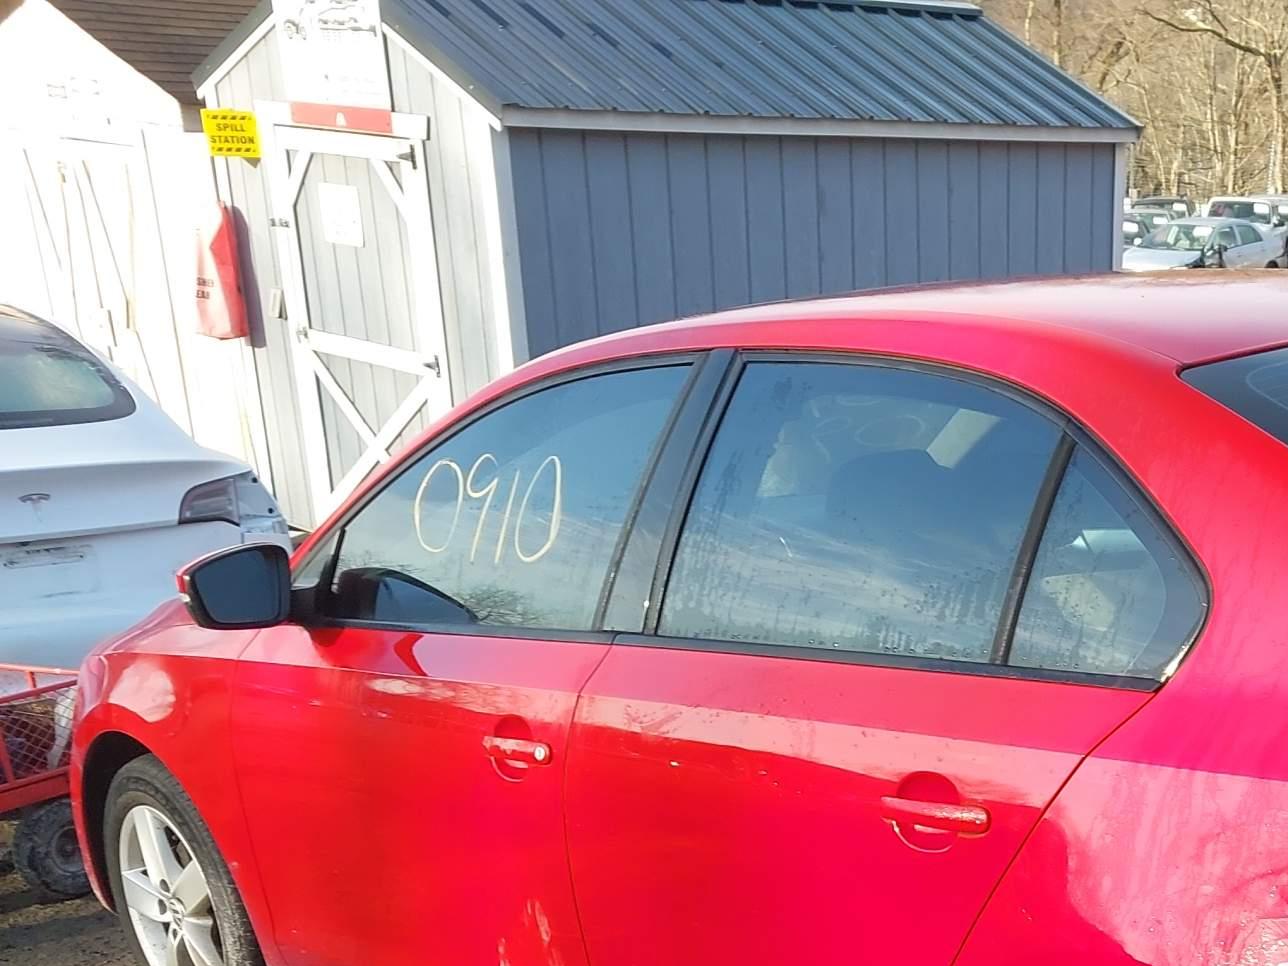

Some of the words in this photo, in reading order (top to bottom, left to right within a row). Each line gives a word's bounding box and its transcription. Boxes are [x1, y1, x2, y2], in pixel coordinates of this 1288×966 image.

[215, 122, 246, 132] SPILL
[210, 135, 255, 145] STATION
[414, 453, 562, 564] 0910
